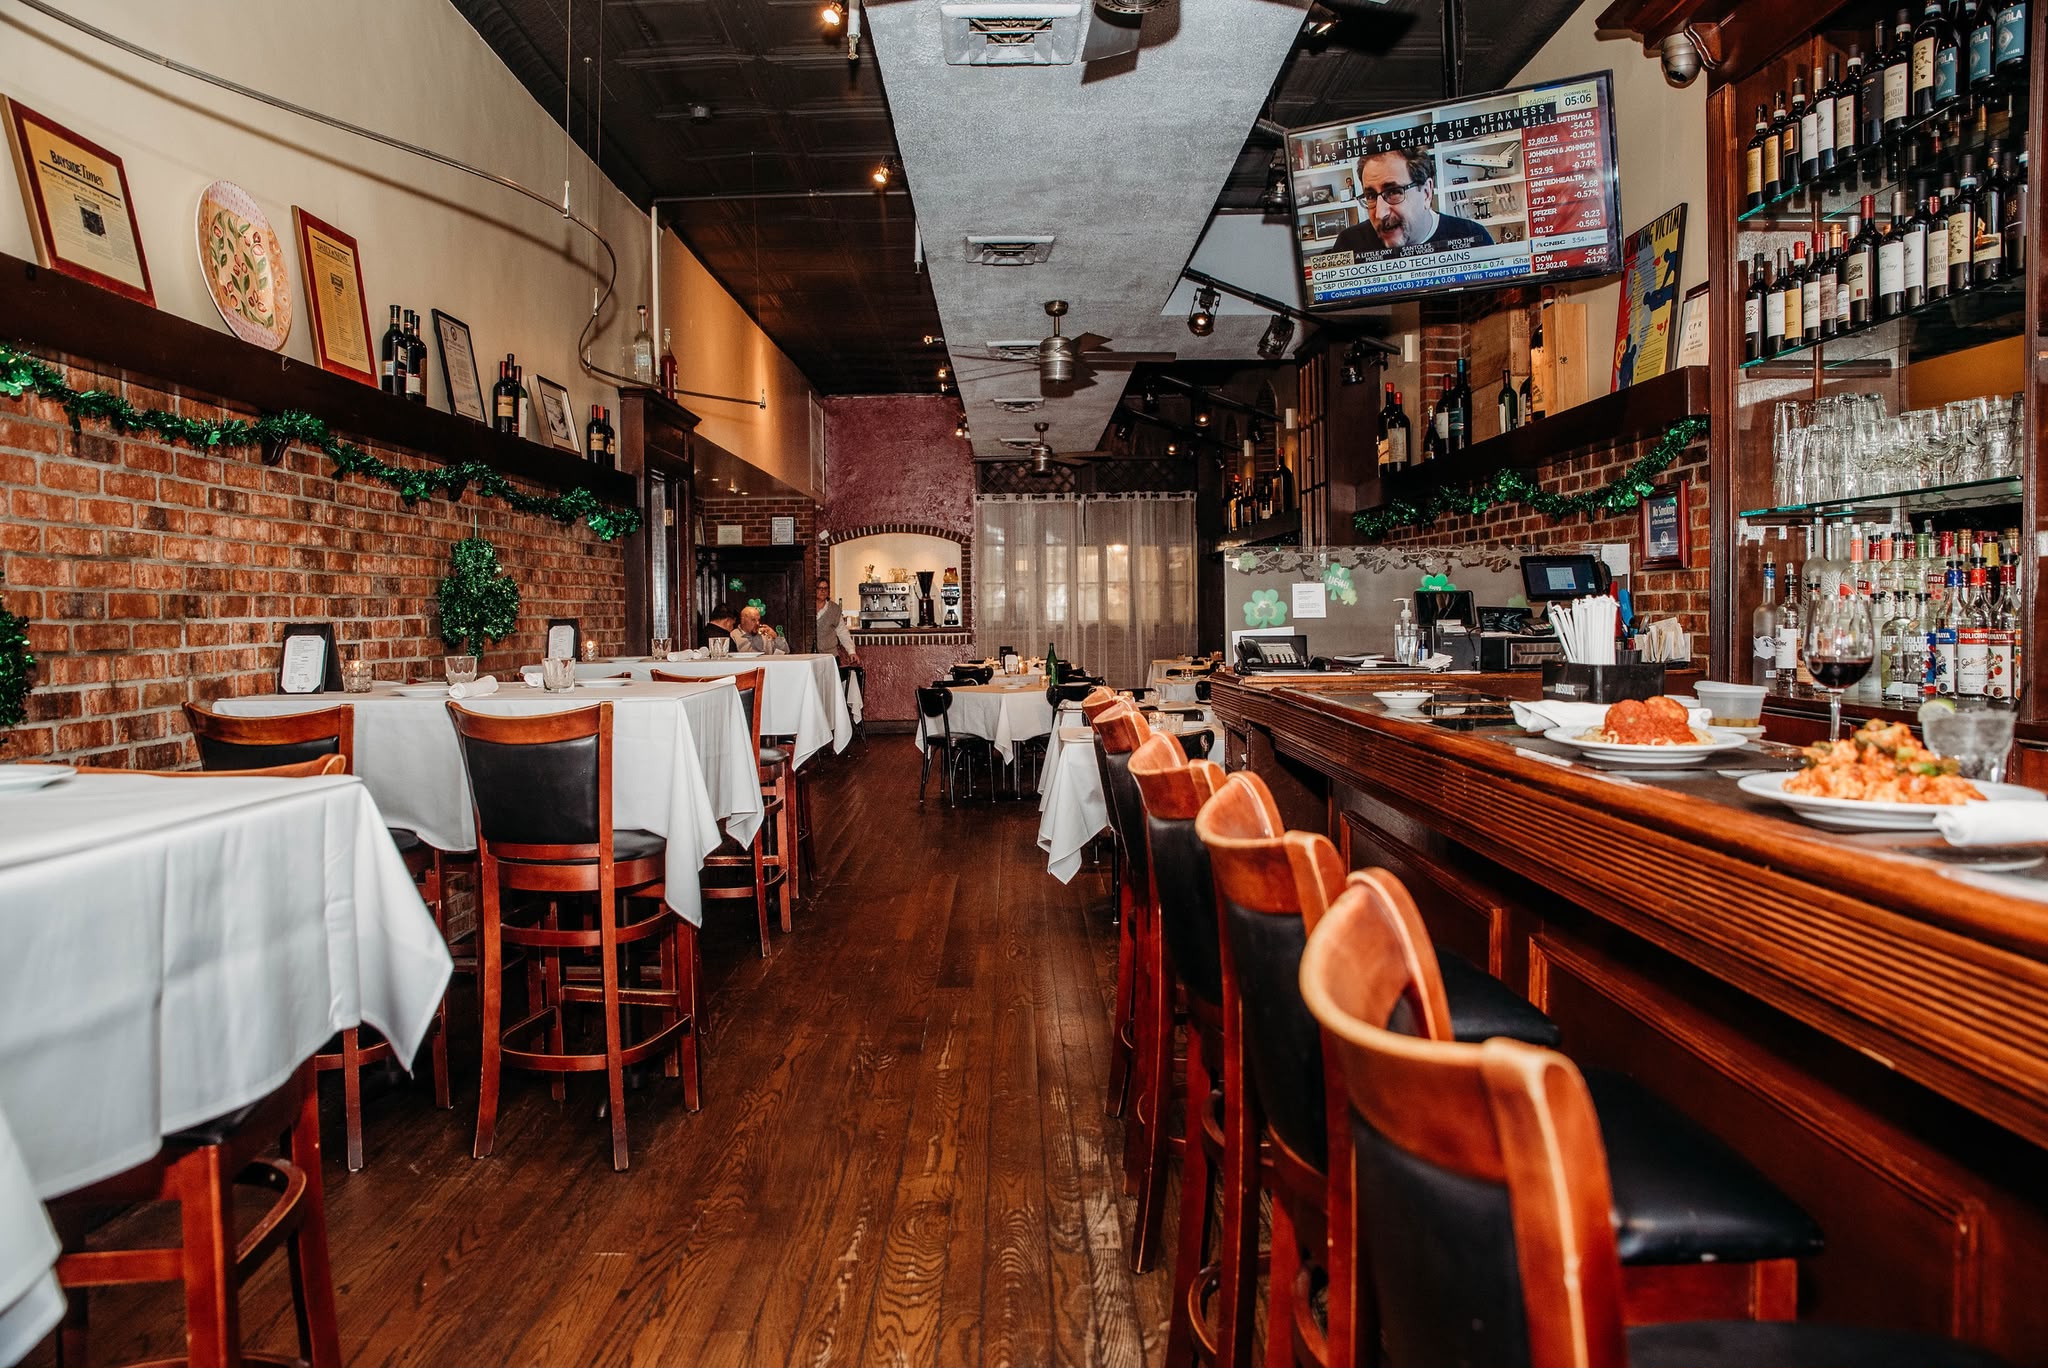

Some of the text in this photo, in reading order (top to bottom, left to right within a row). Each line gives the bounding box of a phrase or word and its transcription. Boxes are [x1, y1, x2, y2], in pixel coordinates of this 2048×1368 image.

[1565, 94, 1592, 106] 05:06
[1556, 112, 1592, 123] USTRIALS
[1316, 105, 1545, 154] I THINK A LOT OF THE WEAKNESS
[1571, 120, 1594, 129] -54.43
[1316, 114, 1554, 162] WAS DUE TO CHINA SO CHINA WILL
[1570, 130, 1595, 139] -0.17%
[1528, 135, 1558, 146] 32,802.03
[1528, 148, 1558, 158] JOHNSON
[1565, 142, 1596, 152] JOHNSON
[1577, 150, 1596, 159] -1.14
[50, 149, 82, 176] BAYSIDE
[80, 164, 104, 186] Times
[1572, 160, 1596, 169] -0.74%
[1530, 166, 1554, 176] 152.95
[1530, 174, 1584, 188] UNITEDHEALTH
[1579, 180, 1598, 188] -2.68
[1574, 189, 1599, 198] -0.57%
[1532, 196, 1556, 205] 471.20
[1532, 208, 1557, 217] PFIZER
[1582, 209, 1600, 218] -0.23
[1576, 219, 1600, 228] -0.56%
[1655, 207, 1680, 242] VICTIM
[1534, 226, 1554, 234] 40.12
[1361, 250, 1380, 258] LITTLE
[1400, 250, 1416, 258] LAST
[1585, 248, 1606, 256] -54.43
[1313, 255, 1326, 264] CHIP
[1340, 252, 1351, 260] THE
[1328, 258, 1351, 268] BLOCK
[1584, 256, 1607, 264] -0.17%
[1315, 252, 1470, 281] CHIP STOCKS LEAD TECH GAINS
[1536, 260, 1568, 271] 32,802.03
[1331, 290, 1360, 298] Columbia
[1362, 286, 1388, 295] Banking
[1390, 281, 1414, 290] (COLB)
[1416, 280, 1434, 288] 27.34
[1485, 269, 1510, 278] Towers
[1511, 265, 1530, 274] Wats
[1338, 280, 1362, 289] (UPRO)
[1364, 276, 1380, 285] 35.89
[1388, 274, 1402, 282] 0.14
[1410, 270, 1436, 278] Entergy
[1438, 266, 1458, 276] (ETR)
[1460, 264, 1480, 272] 103.84
[1688, 320, 1702, 331] CPR
